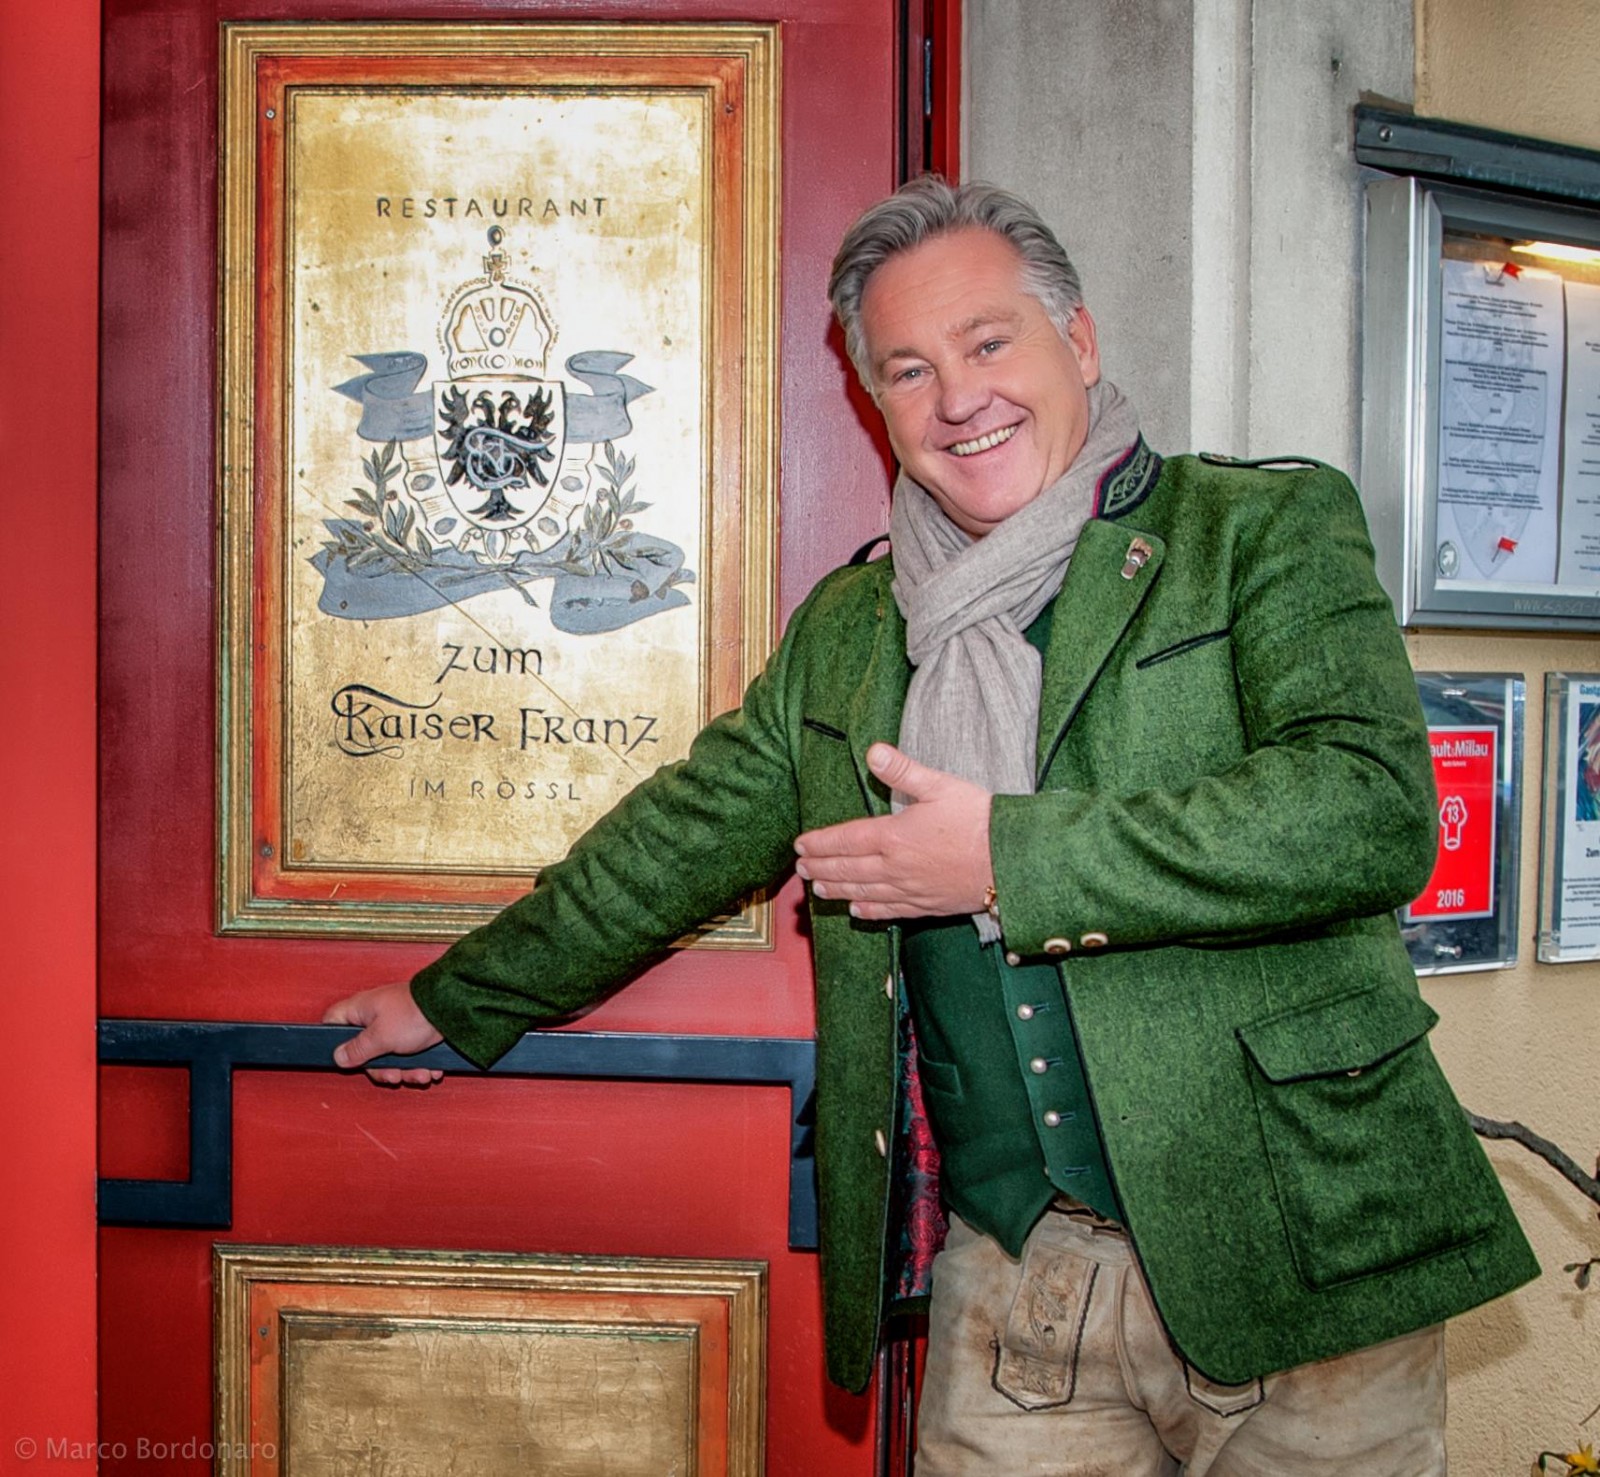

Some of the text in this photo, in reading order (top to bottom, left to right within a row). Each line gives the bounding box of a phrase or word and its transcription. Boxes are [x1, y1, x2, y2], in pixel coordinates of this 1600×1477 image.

[376, 197, 608, 219] RESTAURANT
[331, 683, 659, 759] Kaiser Franz
[410, 775, 582, 801] IM RÖSSL
[1446, 804, 1459, 824] 13
[1436, 888, 1465, 909] 2016
